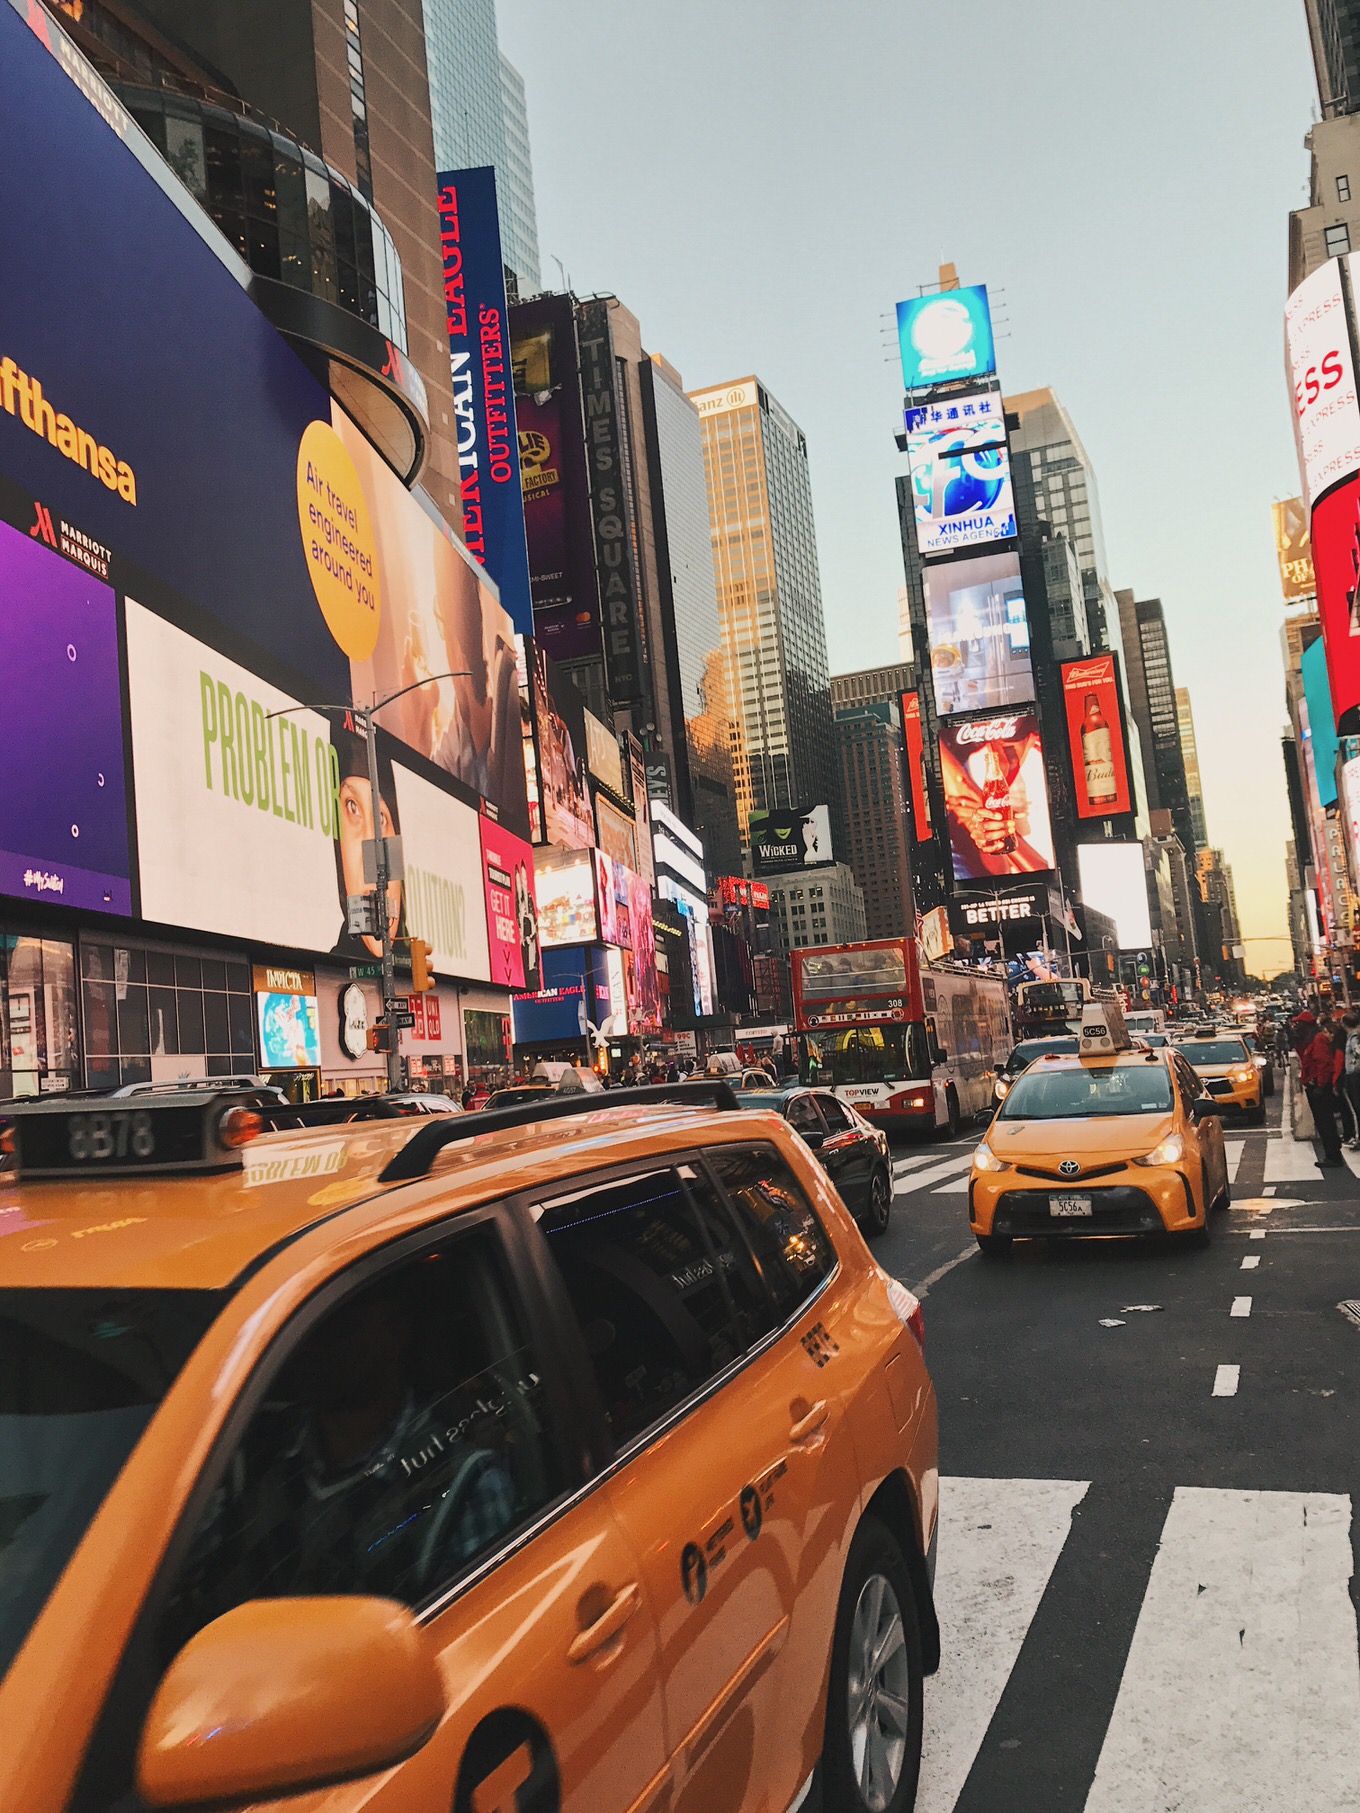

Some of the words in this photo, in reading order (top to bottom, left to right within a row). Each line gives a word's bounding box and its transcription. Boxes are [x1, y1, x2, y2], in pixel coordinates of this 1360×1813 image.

[479, 307, 512, 484] OUTFITTERS
[0, 356, 137, 507] fthansa
[525, 470, 557, 489] FACTORY
[307, 461, 323, 497] Air
[327, 481, 358, 533] travel
[583, 337, 613, 471] TIMES
[599, 487, 631, 656] SQUARE
[309, 503, 372, 577] engineered
[939, 516, 994, 535] XINHUA
[60, 520, 112, 563] MARRIOTT
[927, 535, 959, 547] NEWS
[61, 537, 107, 576] MARQUIS
[312, 539, 353, 592] around
[355, 578, 375, 611] you
[200, 669, 314, 830] PROBLEM
[315, 736, 344, 840] OR
[966, 903, 1031, 924] BETTER
[495, 915, 516, 944] HERE
[358, 968, 364, 976] W
[367, 966, 375, 975] 45
[513, 988, 558, 1001] AMERICAN
[559, 985, 585, 996] EAGLE
[888, 999, 902, 1008] 308
[1084, 1027, 1106, 1036] 5C56
[844, 1088, 879, 1097] TOPVIEW
